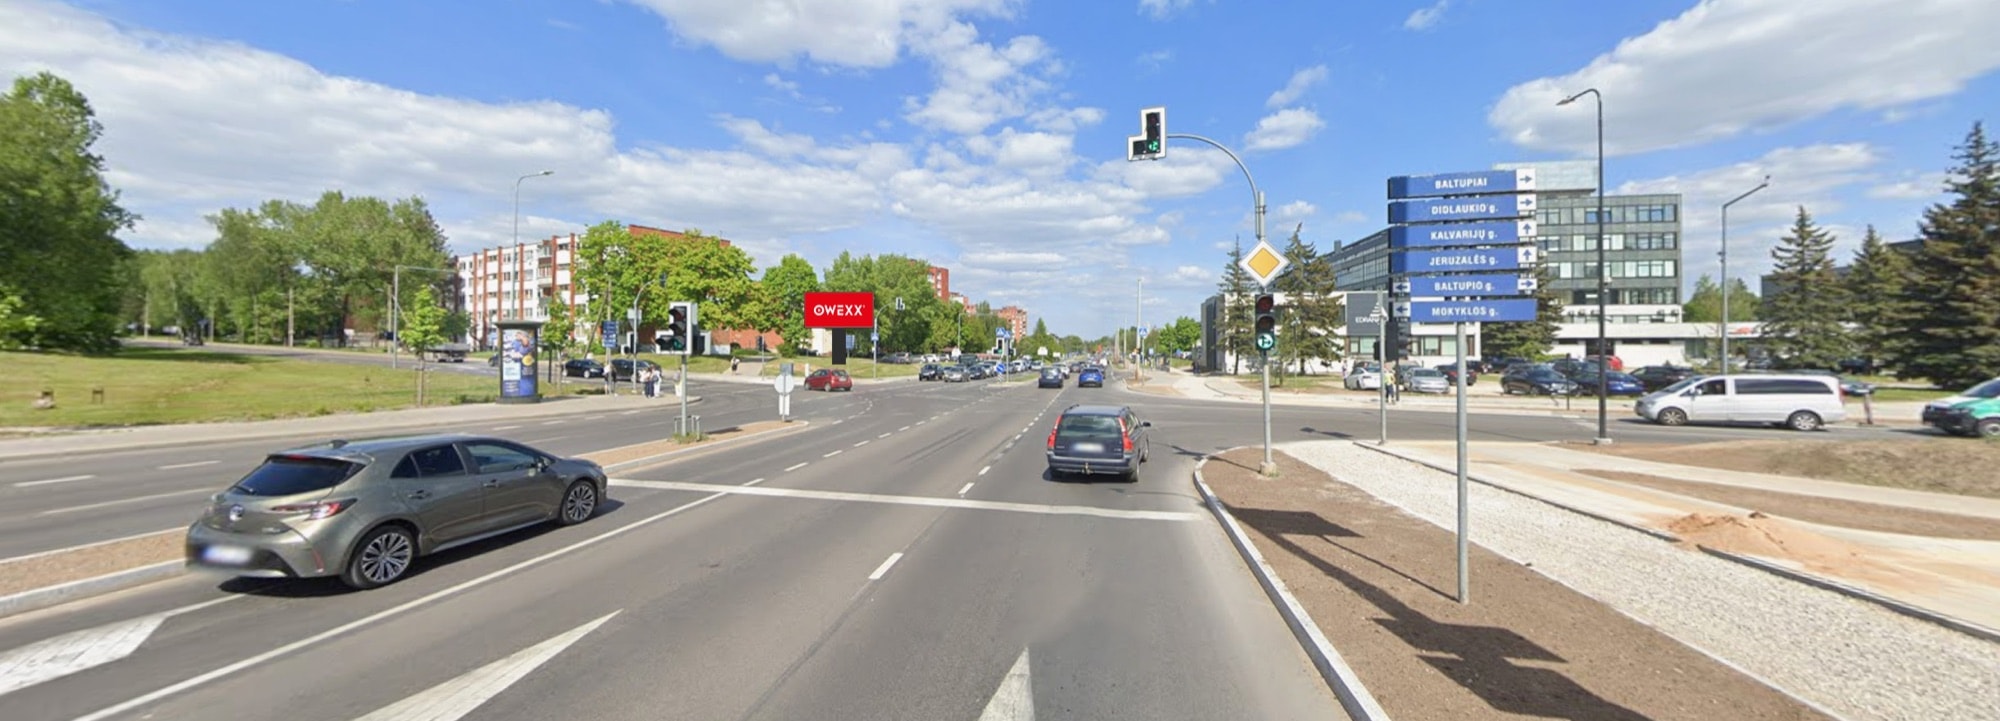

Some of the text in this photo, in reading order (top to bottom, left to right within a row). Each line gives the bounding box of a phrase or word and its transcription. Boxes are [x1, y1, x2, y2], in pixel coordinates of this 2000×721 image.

[1435, 178, 1488, 189] BALTUPIAI
[1431, 205, 1498, 214] DIDLAUKIO g.
[1430, 230, 1498, 240] KALVARIJŲ g.
[1429, 254, 1498, 266] JERUZALĖS g.
[1434, 281, 1495, 292] BALTUPIO g.
[813, 304, 863, 316] OWEXX
[1431, 306, 1498, 316] MOKYKLOS g.
